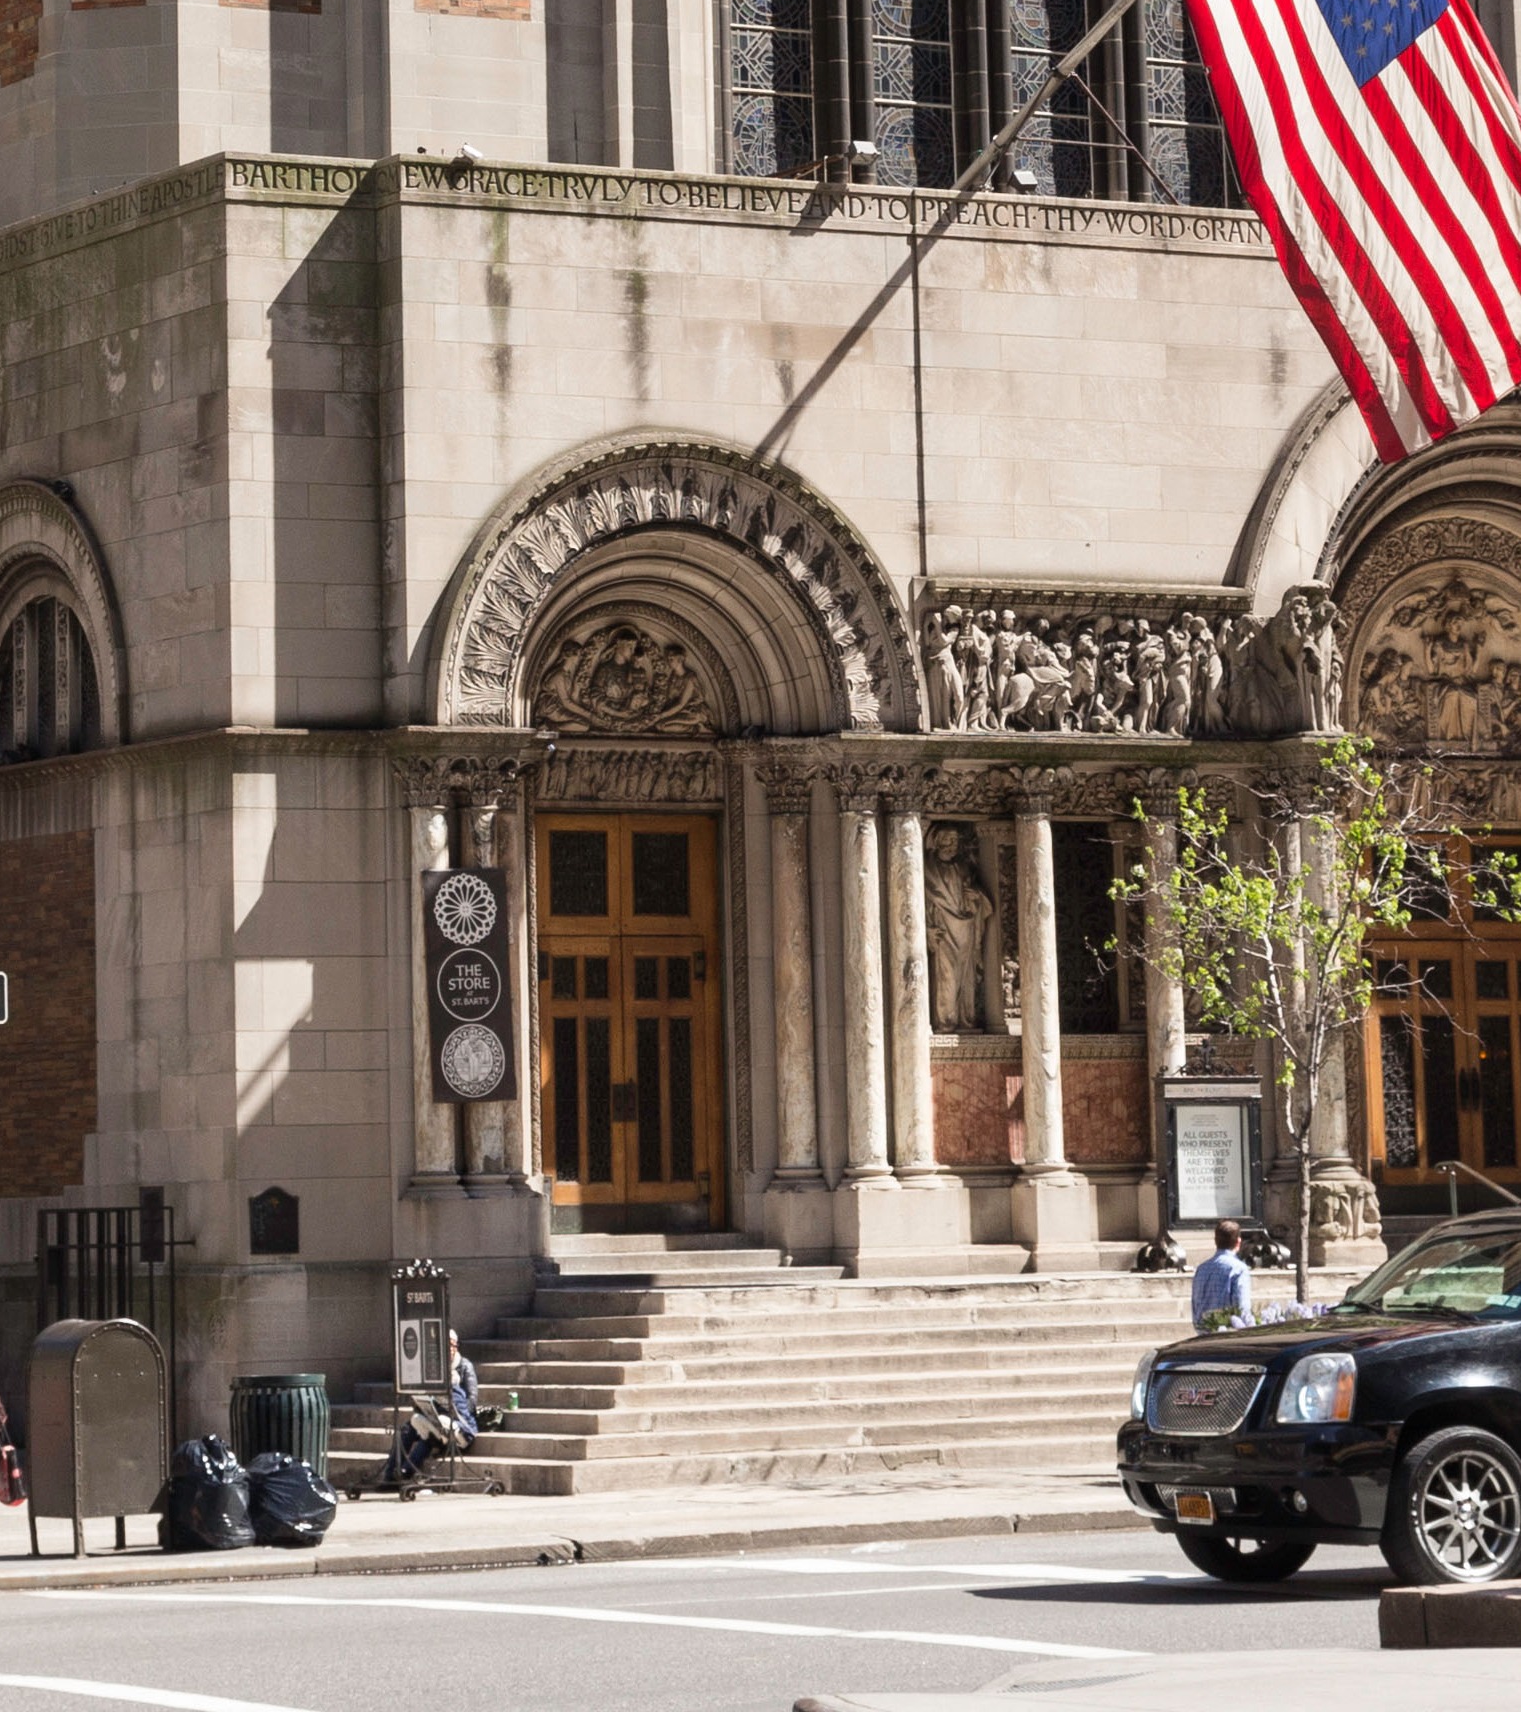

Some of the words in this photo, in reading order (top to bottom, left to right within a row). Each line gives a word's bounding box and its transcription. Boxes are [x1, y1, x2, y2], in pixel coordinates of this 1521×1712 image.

[100, 186, 149, 225] THINE
[150, 162, 225, 211] APOSTLE
[642, 180, 681, 206] TO
[688, 183, 804, 214] BELIEVE
[805, 190, 865, 219] AND
[877, 196, 908, 222] TO
[920, 199, 1031, 229] PREACH
[1036, 206, 1099, 233] THY
[1105, 209, 1187, 240] WORD
[1193, 218, 1265, 245] GRAN
[455, 964, 482, 977] THE
[448, 977, 491, 991] STORE
[1183, 1130, 1198, 1139] ALL
[1198, 1130, 1228, 1139] GUESTS
[1178, 1139, 1198, 1148] WHO
[1198, 1139, 1233, 1148] PRESENT
[1174, 1388, 1217, 1406] GMC
